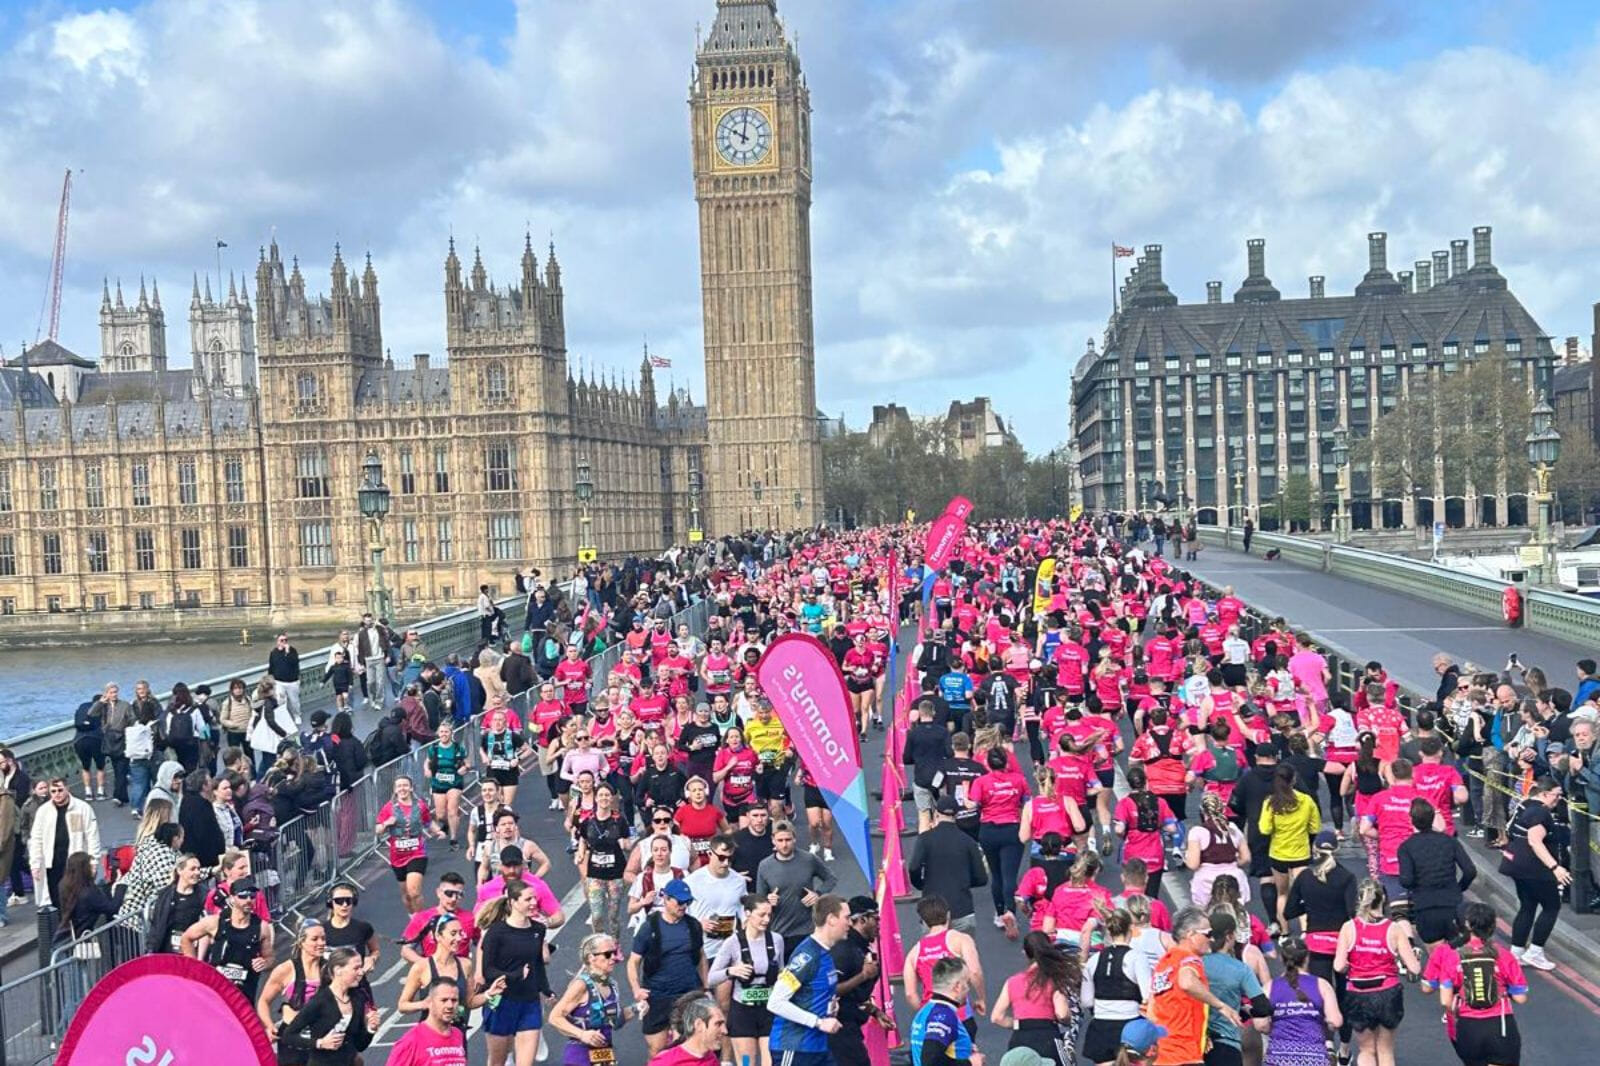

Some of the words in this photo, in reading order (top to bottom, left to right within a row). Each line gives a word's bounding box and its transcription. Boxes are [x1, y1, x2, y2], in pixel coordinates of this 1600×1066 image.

[930, 523, 956, 562] Tommy's
[1361, 937, 1381, 945] Team
[1355, 944, 1388, 954] Tommy's
